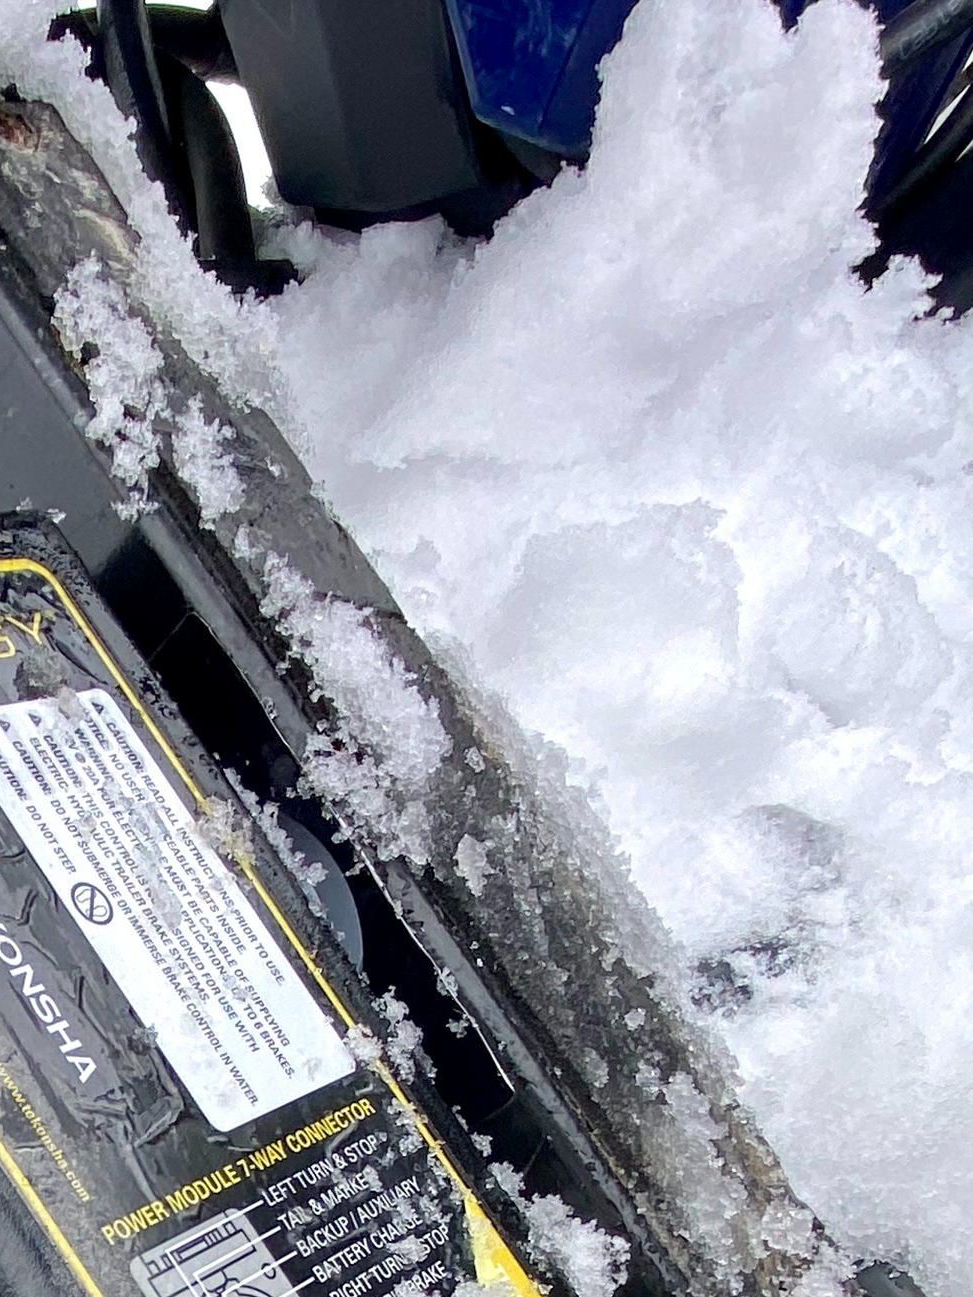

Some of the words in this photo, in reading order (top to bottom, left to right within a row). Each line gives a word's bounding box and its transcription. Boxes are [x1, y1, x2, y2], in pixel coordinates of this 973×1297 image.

[24, 804, 44, 822] DO
[35, 821, 60, 846] NOT
[51, 845, 79, 875] STEP.
[40, 733, 85, 789] CAUTION:
[79, 791, 105, 819] THIS
[97, 819, 141, 874] CONTROL
[134, 873, 150, 887] IS
[199, 971, 222, 996] FOR
[215, 995, 239, 1021] USE
[231, 1019, 260, 1054] WITH
[103, 720, 147, 774] CAUTION:
[138, 773, 168, 804] READ
[159, 803, 183, 827] ALL
[229, 907, 261, 943] PRIOR
[253, 942, 272, 960] TO
[263, 957, 290, 986] USE.
[106, 753, 126, 771] NO
[118, 771, 147, 802] USER
[189, 876, 221, 914] PARTS
[214, 912, 250, 956] INSIDE.
[9, 739, 55, 796] CAUTION:
[48, 798, 68, 816] DO
[60, 815, 84, 840] NOT
[76, 839, 123, 899] SUBMERGE
[115, 898, 134, 915] OR
[125, 914, 167, 966] IMMERSE
[159, 965, 192, 1003] BRAKE
[183, 1001, 225, 1053] CONTROL
[217, 1051, 234, 1067] IN
[226, 1065, 261, 1109] WATER.
[80, 764, 102, 786] 20A
[94, 786, 118, 809] FOR
[240, 1002, 259, 1022] TO
[257, 1029, 298, 1080] BRAKES.
[108, 859, 148, 907] TRAILER
[140, 907, 174, 947] BRAKE
[166, 946, 213, 1006] SYSTEMS.
[162, 864, 193, 899] MUST
[185, 899, 204, 916] BE
[197, 915, 239, 968] CAPABLE
[231, 967, 250, 985] OF
[100, 1200, 169, 1245] POWER
[164, 1164, 241, 1213] MODULE
[235, 1139, 287, 1177] 7-WAY
[285, 1098, 376, 1152] CONNECTOR
[261, 1177, 296, 1206] LEFT
[291, 1156, 336, 1192] TURN
[329, 1149, 349, 1171] &
[341, 1132, 382, 1165] STOP
[295, 1215, 348, 1257] BACKUP
[353, 1173, 423, 1225] AUXILIARY
[306, 1194, 326, 1217] &
[319, 1166, 378, 1211] MARKE
[311, 1237, 371, 1282] BATTERY
[367, 1248, 411, 1286] TURN
[416, 1222, 454, 1255] STOP
